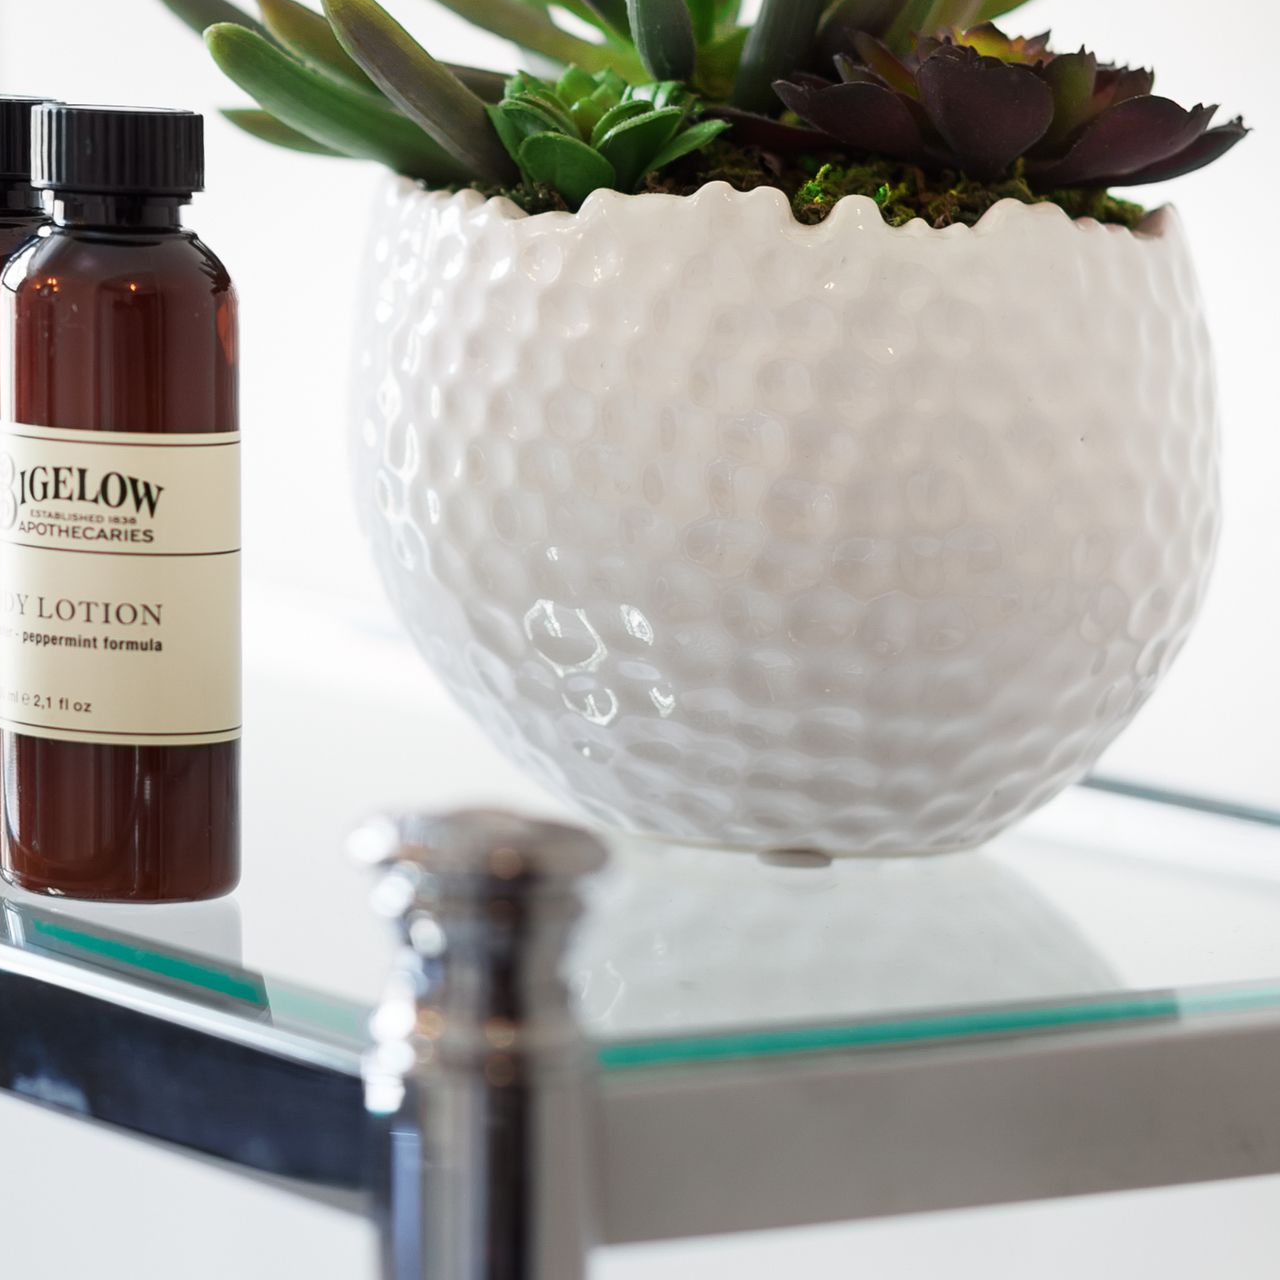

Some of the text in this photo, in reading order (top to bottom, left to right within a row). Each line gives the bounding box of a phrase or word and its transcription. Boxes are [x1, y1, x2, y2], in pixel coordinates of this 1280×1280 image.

[29, 509, 138, 526] ESTABLISHED 1838
[18, 521, 155, 543] APOTHECARIES
[37, 596, 164, 627] LOTION
[22, 630, 98, 650] peppermint
[103, 636, 163, 652] formula
[33, 693, 53, 710] 2,1
[58, 694, 70, 710] fl
[73, 699, 93, 714] oz
